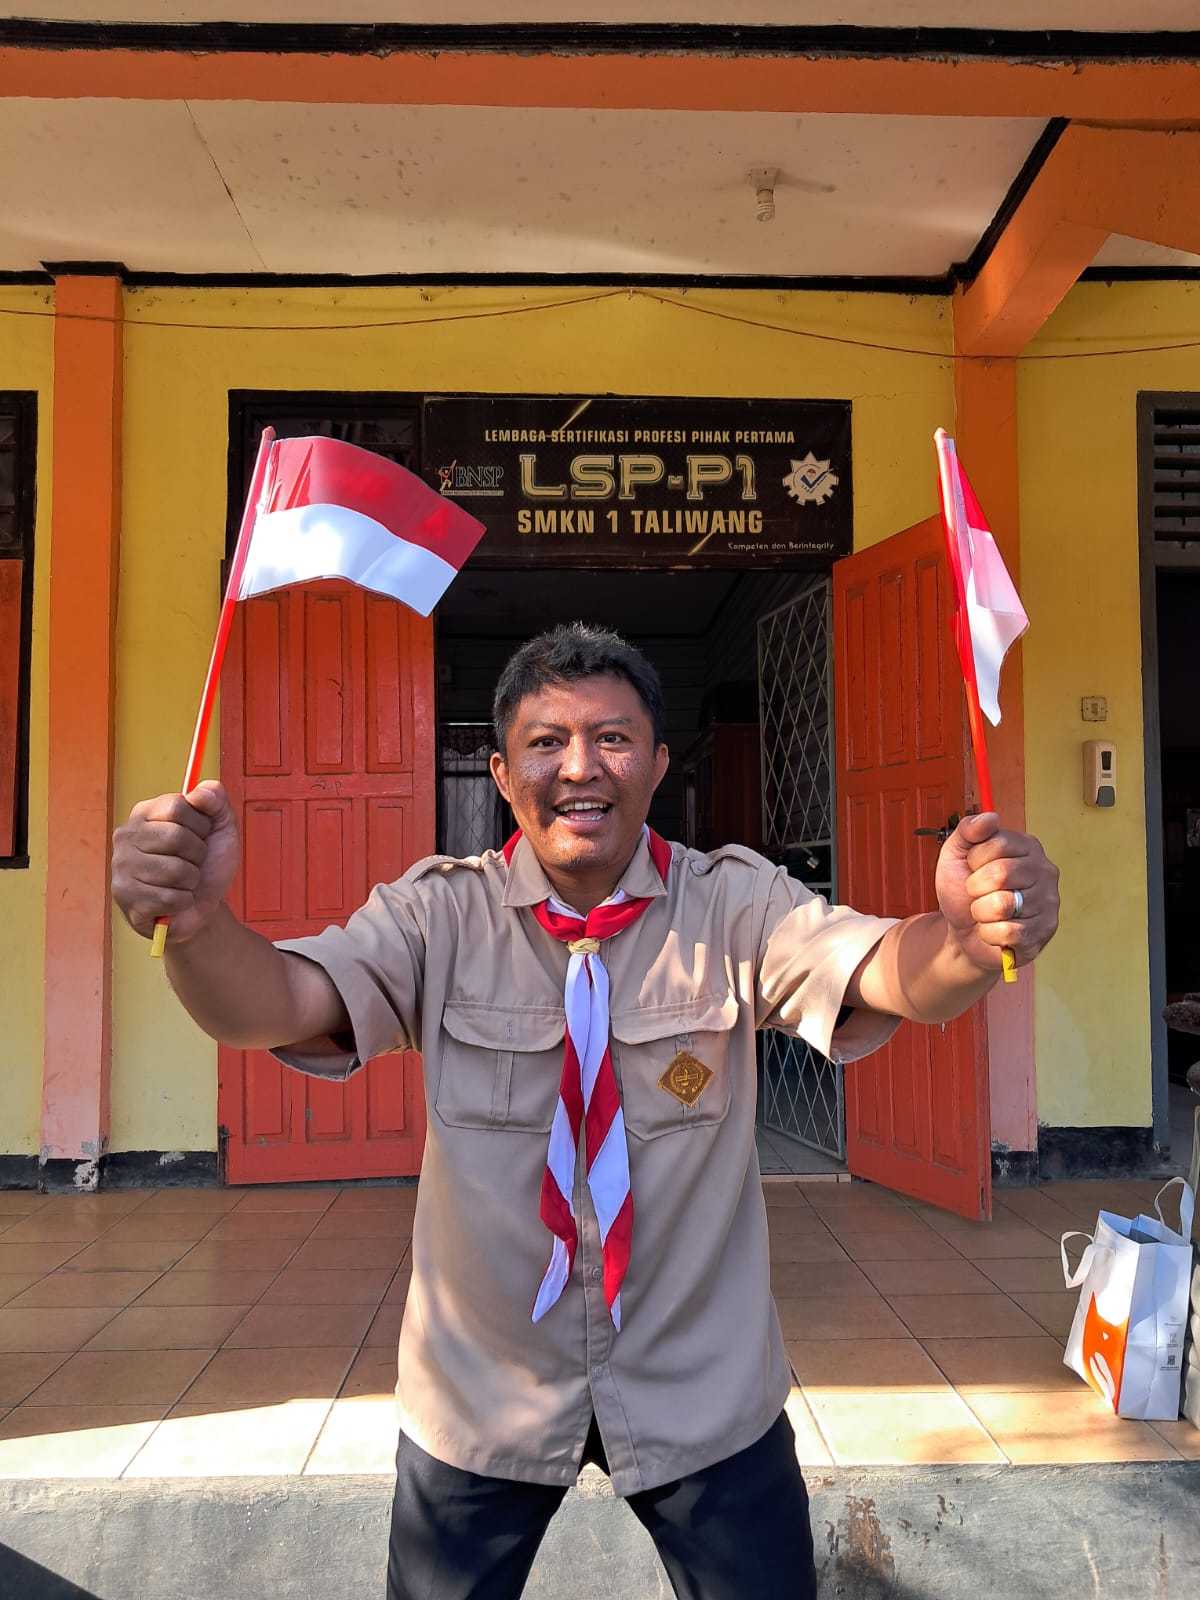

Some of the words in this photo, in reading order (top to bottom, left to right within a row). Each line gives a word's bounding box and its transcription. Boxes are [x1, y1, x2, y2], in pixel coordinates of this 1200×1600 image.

[485, 429, 546, 442] LEMBAGA
[551, 430, 629, 443] SERTIFIKASI
[634, 430, 686, 443] PROFESI
[691, 431, 730, 443] PIHAK
[735, 431, 795, 444] PERTAMA
[455, 466, 505, 488] BNSP
[519, 454, 757, 500] LSP-P1
[517, 509, 594, 534] SMKN
[606, 510, 619, 534] 1
[631, 510, 763, 534] TALIWANG
